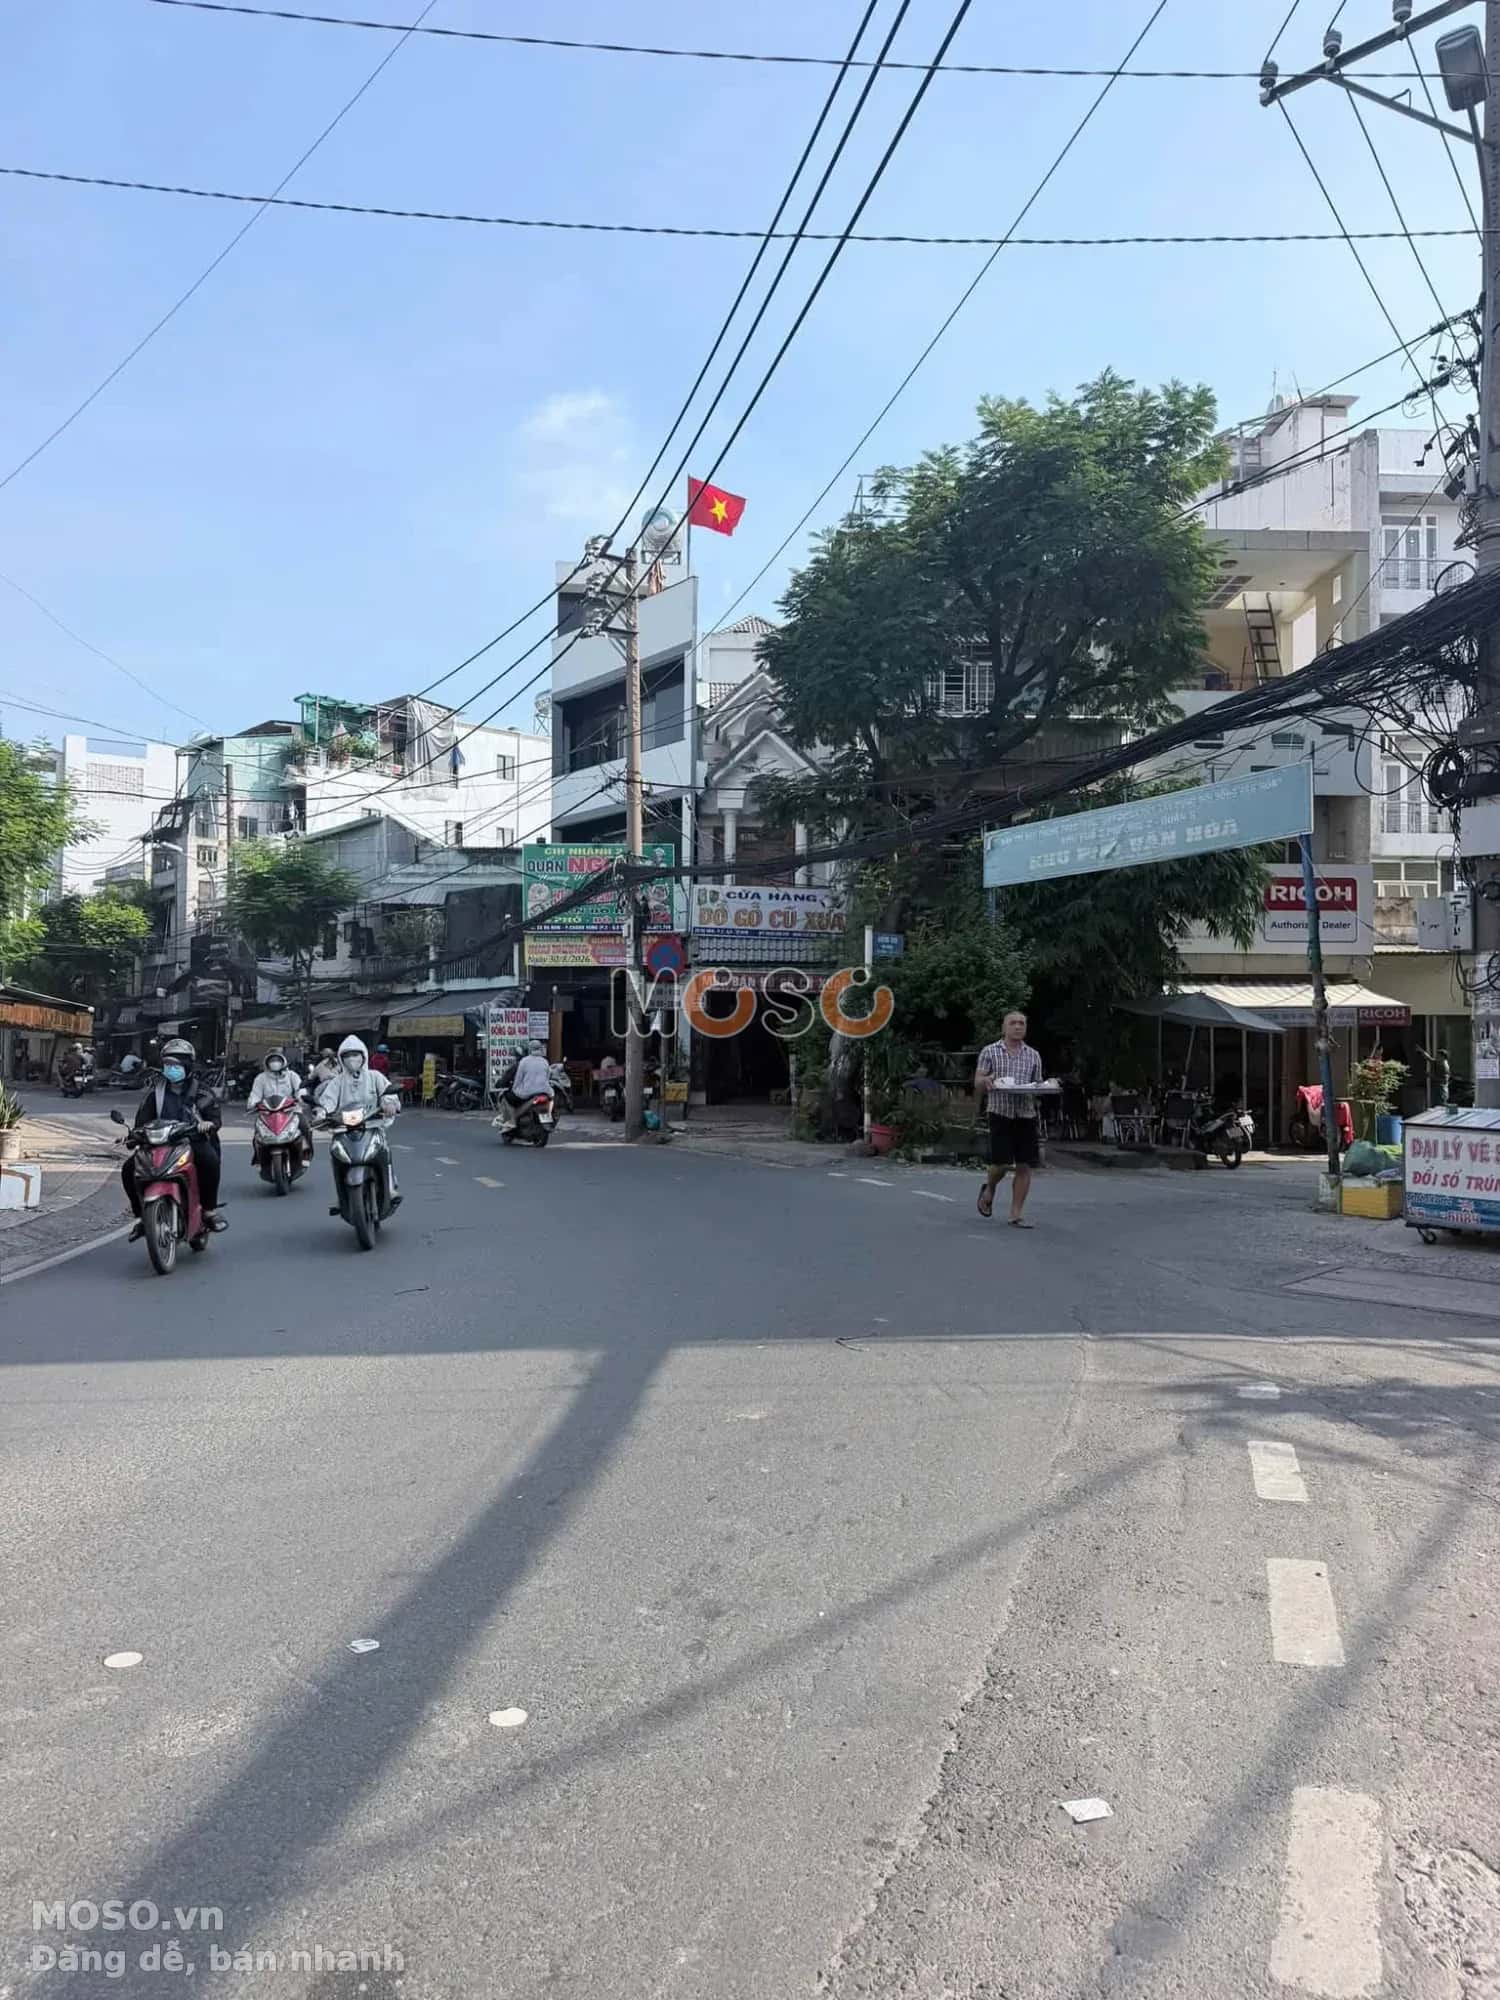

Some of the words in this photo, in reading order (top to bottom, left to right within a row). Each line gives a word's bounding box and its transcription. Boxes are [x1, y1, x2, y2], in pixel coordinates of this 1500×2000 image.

[527, 856, 564, 873] QUÁN
[1029, 850, 1070, 871] KHU
[726, 886, 762, 901] CỬA
[768, 889, 818, 903] HÀNG
[1270, 884, 1352, 902] RICOH
[734, 902, 763, 928] GỖ
[769, 905, 798, 929] CŨ
[1271, 920, 1309, 930] Authoriz
[1322, 920, 1351, 930] Dealer
[504, 1010, 528, 1024] NGON
[1359, 1007, 1407, 1018] RICOH
[1411, 1137, 1439, 1163] ĐẠI
[1443, 1135, 1463, 1161] LÝ
[1467, 1136, 1490, 1163] VÉ
[1412, 1165, 1438, 1187] ĐỔI
[1441, 1169, 1463, 1188] SỐ
